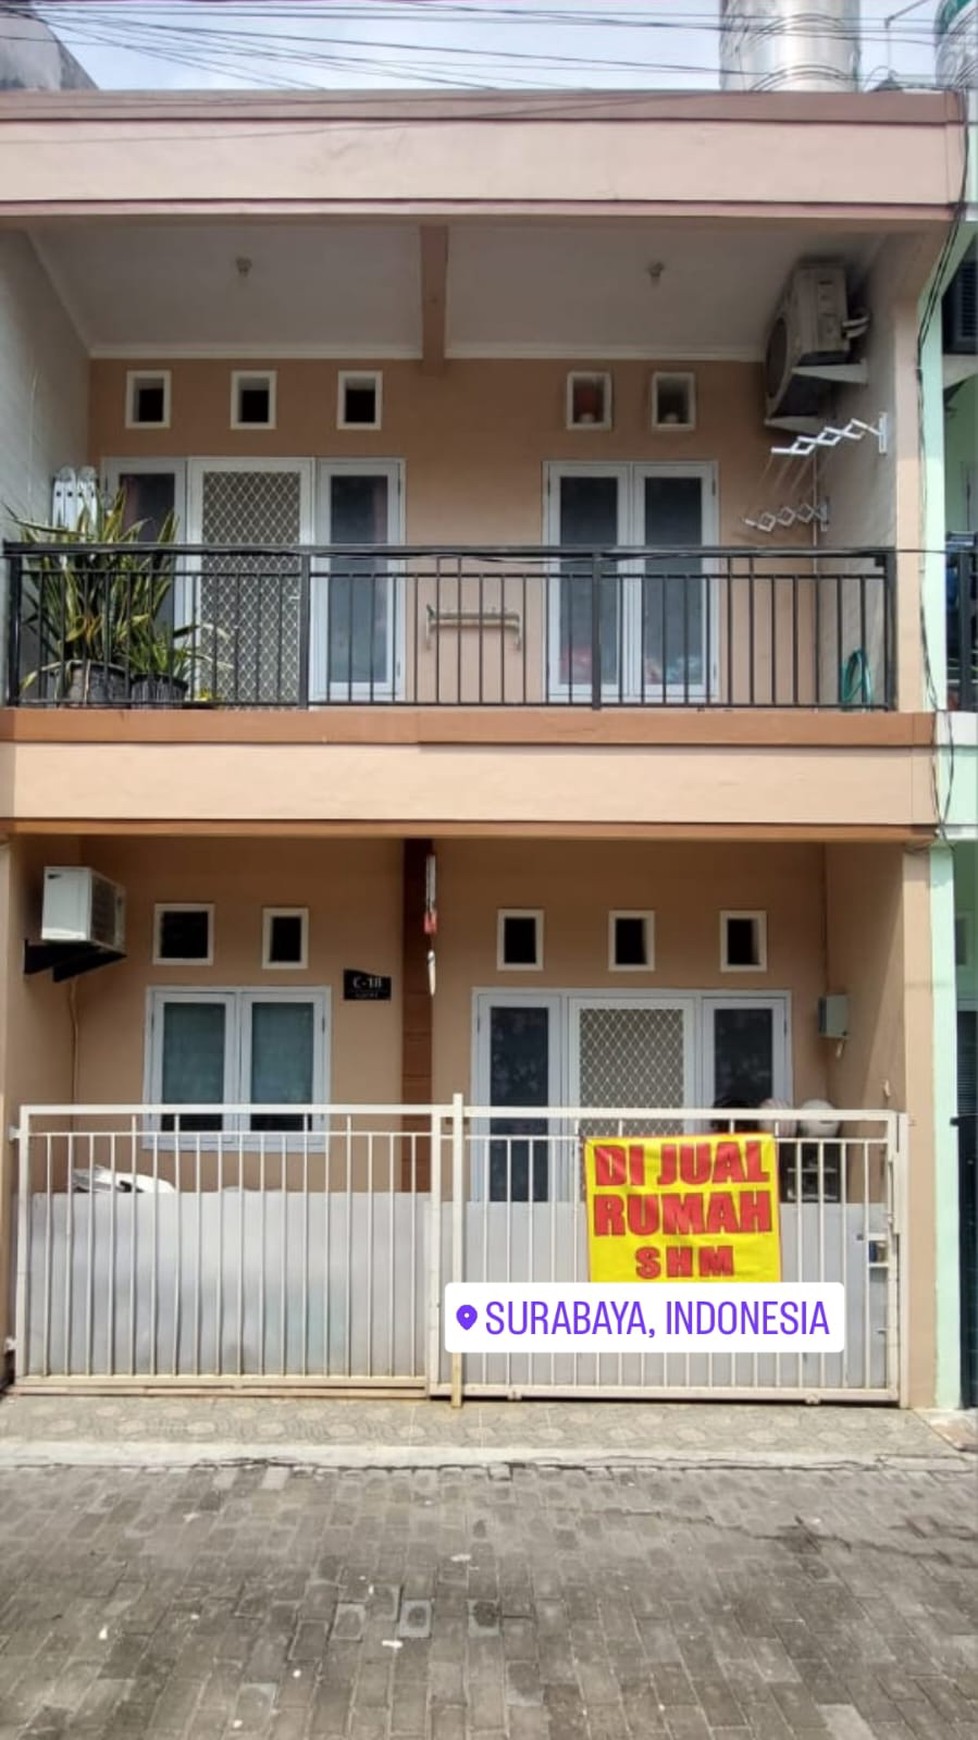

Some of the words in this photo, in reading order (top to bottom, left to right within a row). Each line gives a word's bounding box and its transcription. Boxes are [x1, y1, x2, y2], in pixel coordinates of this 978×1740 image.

[594, 1144, 644, 1186] DI
[657, 1141, 770, 1185] JUAL
[593, 1190, 772, 1236] RUMAH
[635, 1245, 735, 1279] SHM
